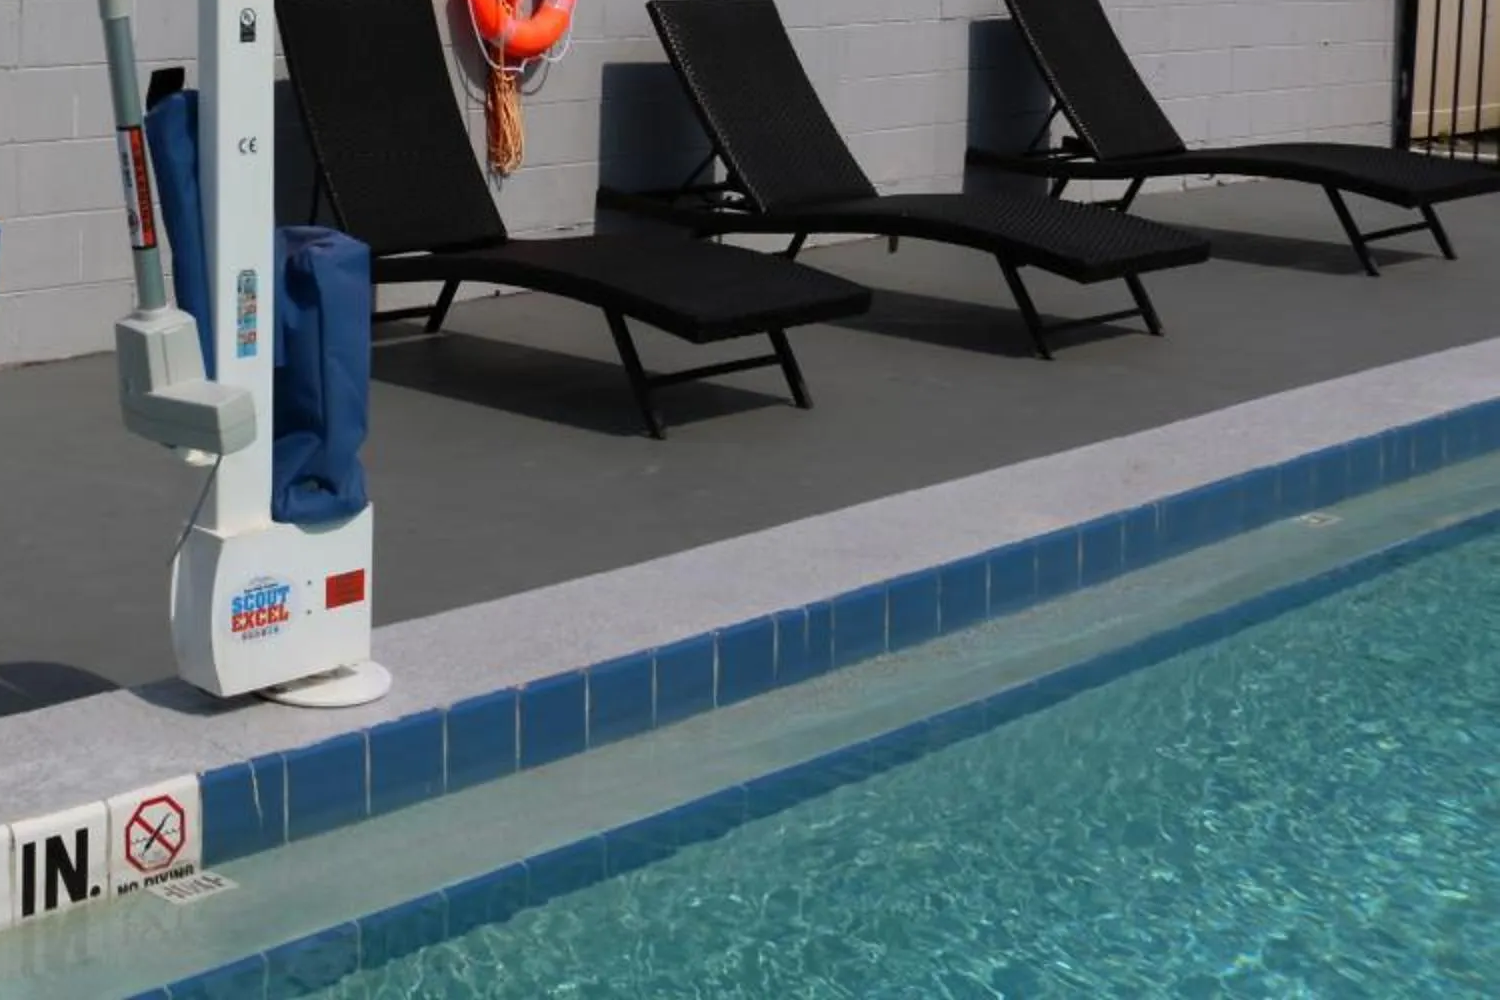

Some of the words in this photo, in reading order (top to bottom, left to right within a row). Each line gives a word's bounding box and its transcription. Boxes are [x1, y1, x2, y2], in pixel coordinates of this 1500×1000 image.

[231, 585, 290, 615] SCOUT
[231, 604, 289, 633] EXCEL
[22, 827, 101, 918] IN.
